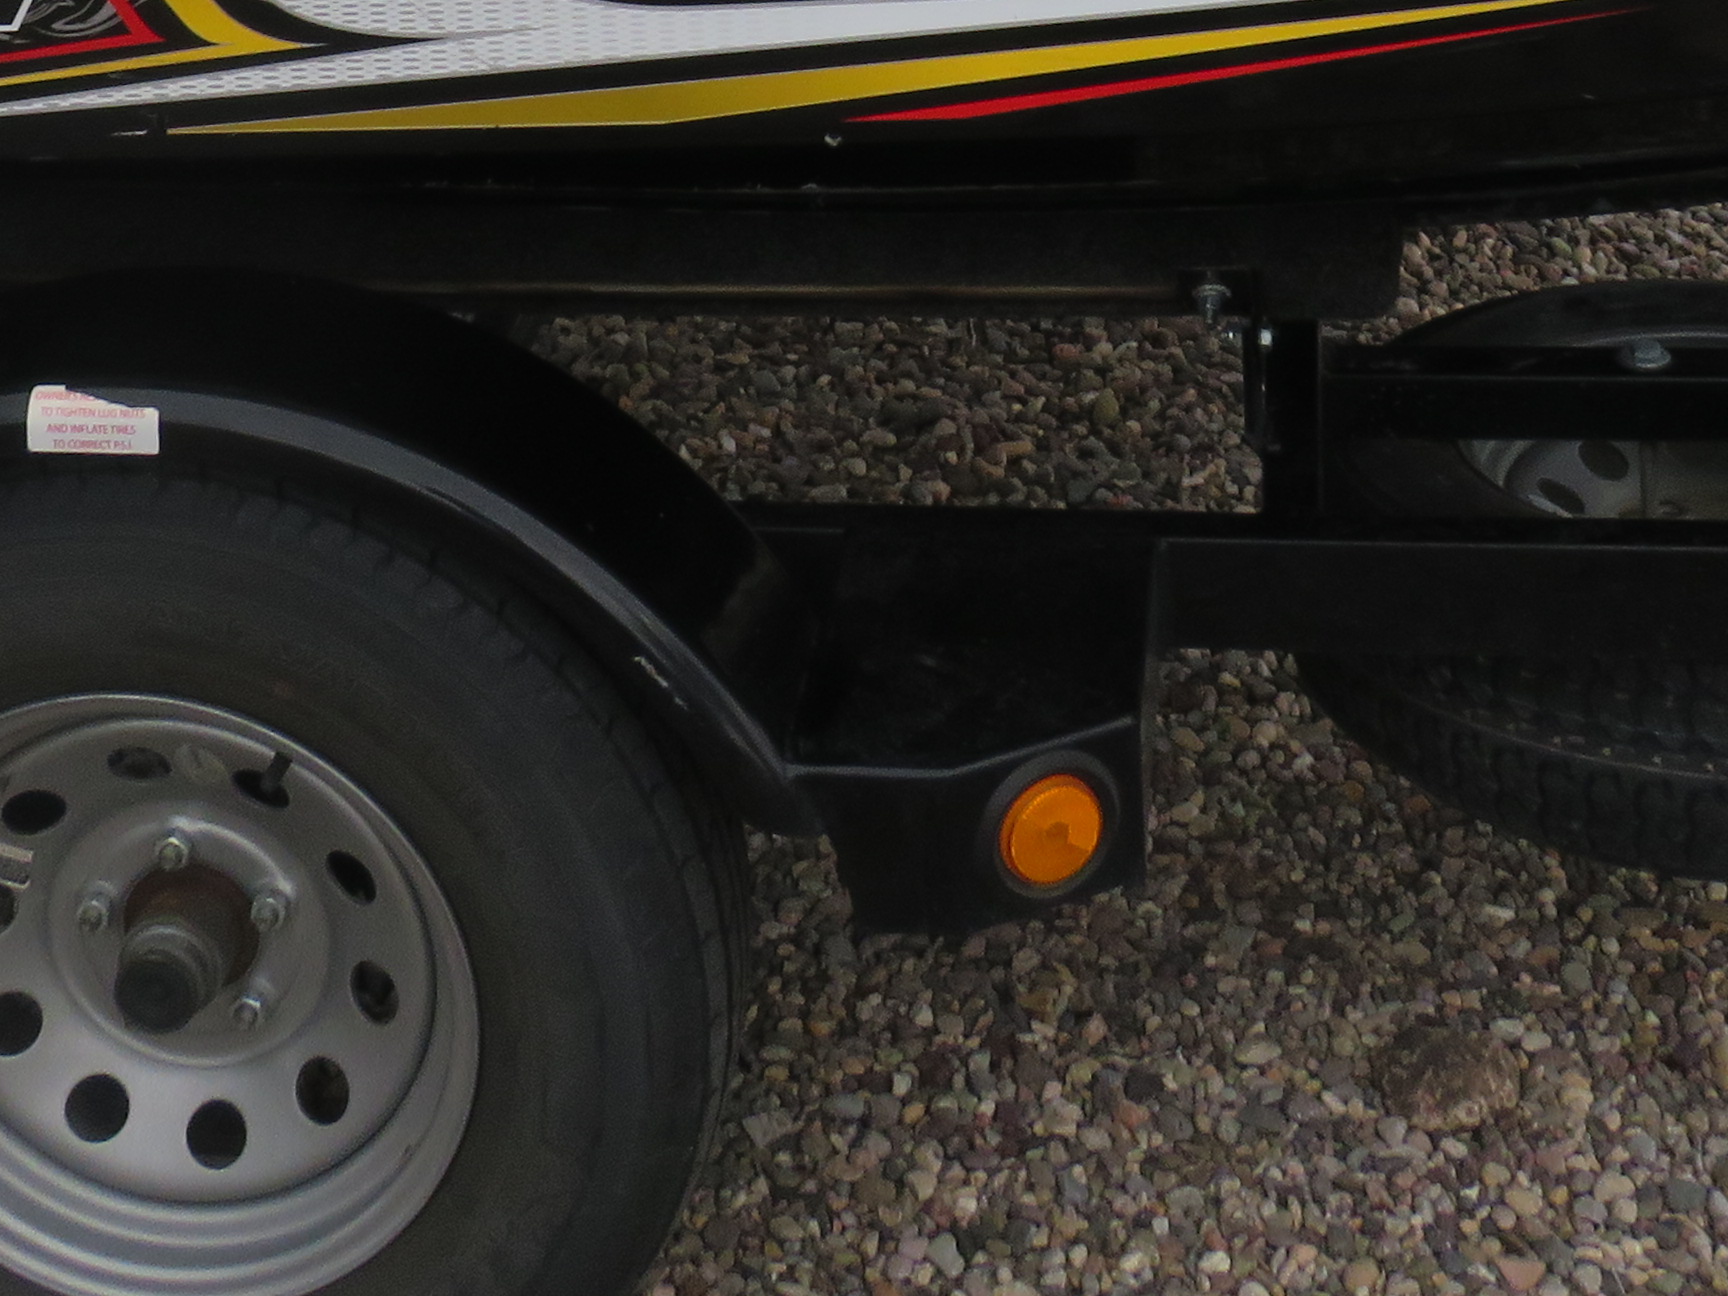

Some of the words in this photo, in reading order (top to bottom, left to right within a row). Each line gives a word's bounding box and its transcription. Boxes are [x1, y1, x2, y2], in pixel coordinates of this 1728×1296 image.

[40, 407, 53, 417] TO
[55, 407, 95, 418] TIGHTEN
[46, 423, 68, 434] AND
[70, 424, 109, 435] INFLATE
[52, 439, 66, 449] TO
[67, 439, 111, 449] CORRECT
